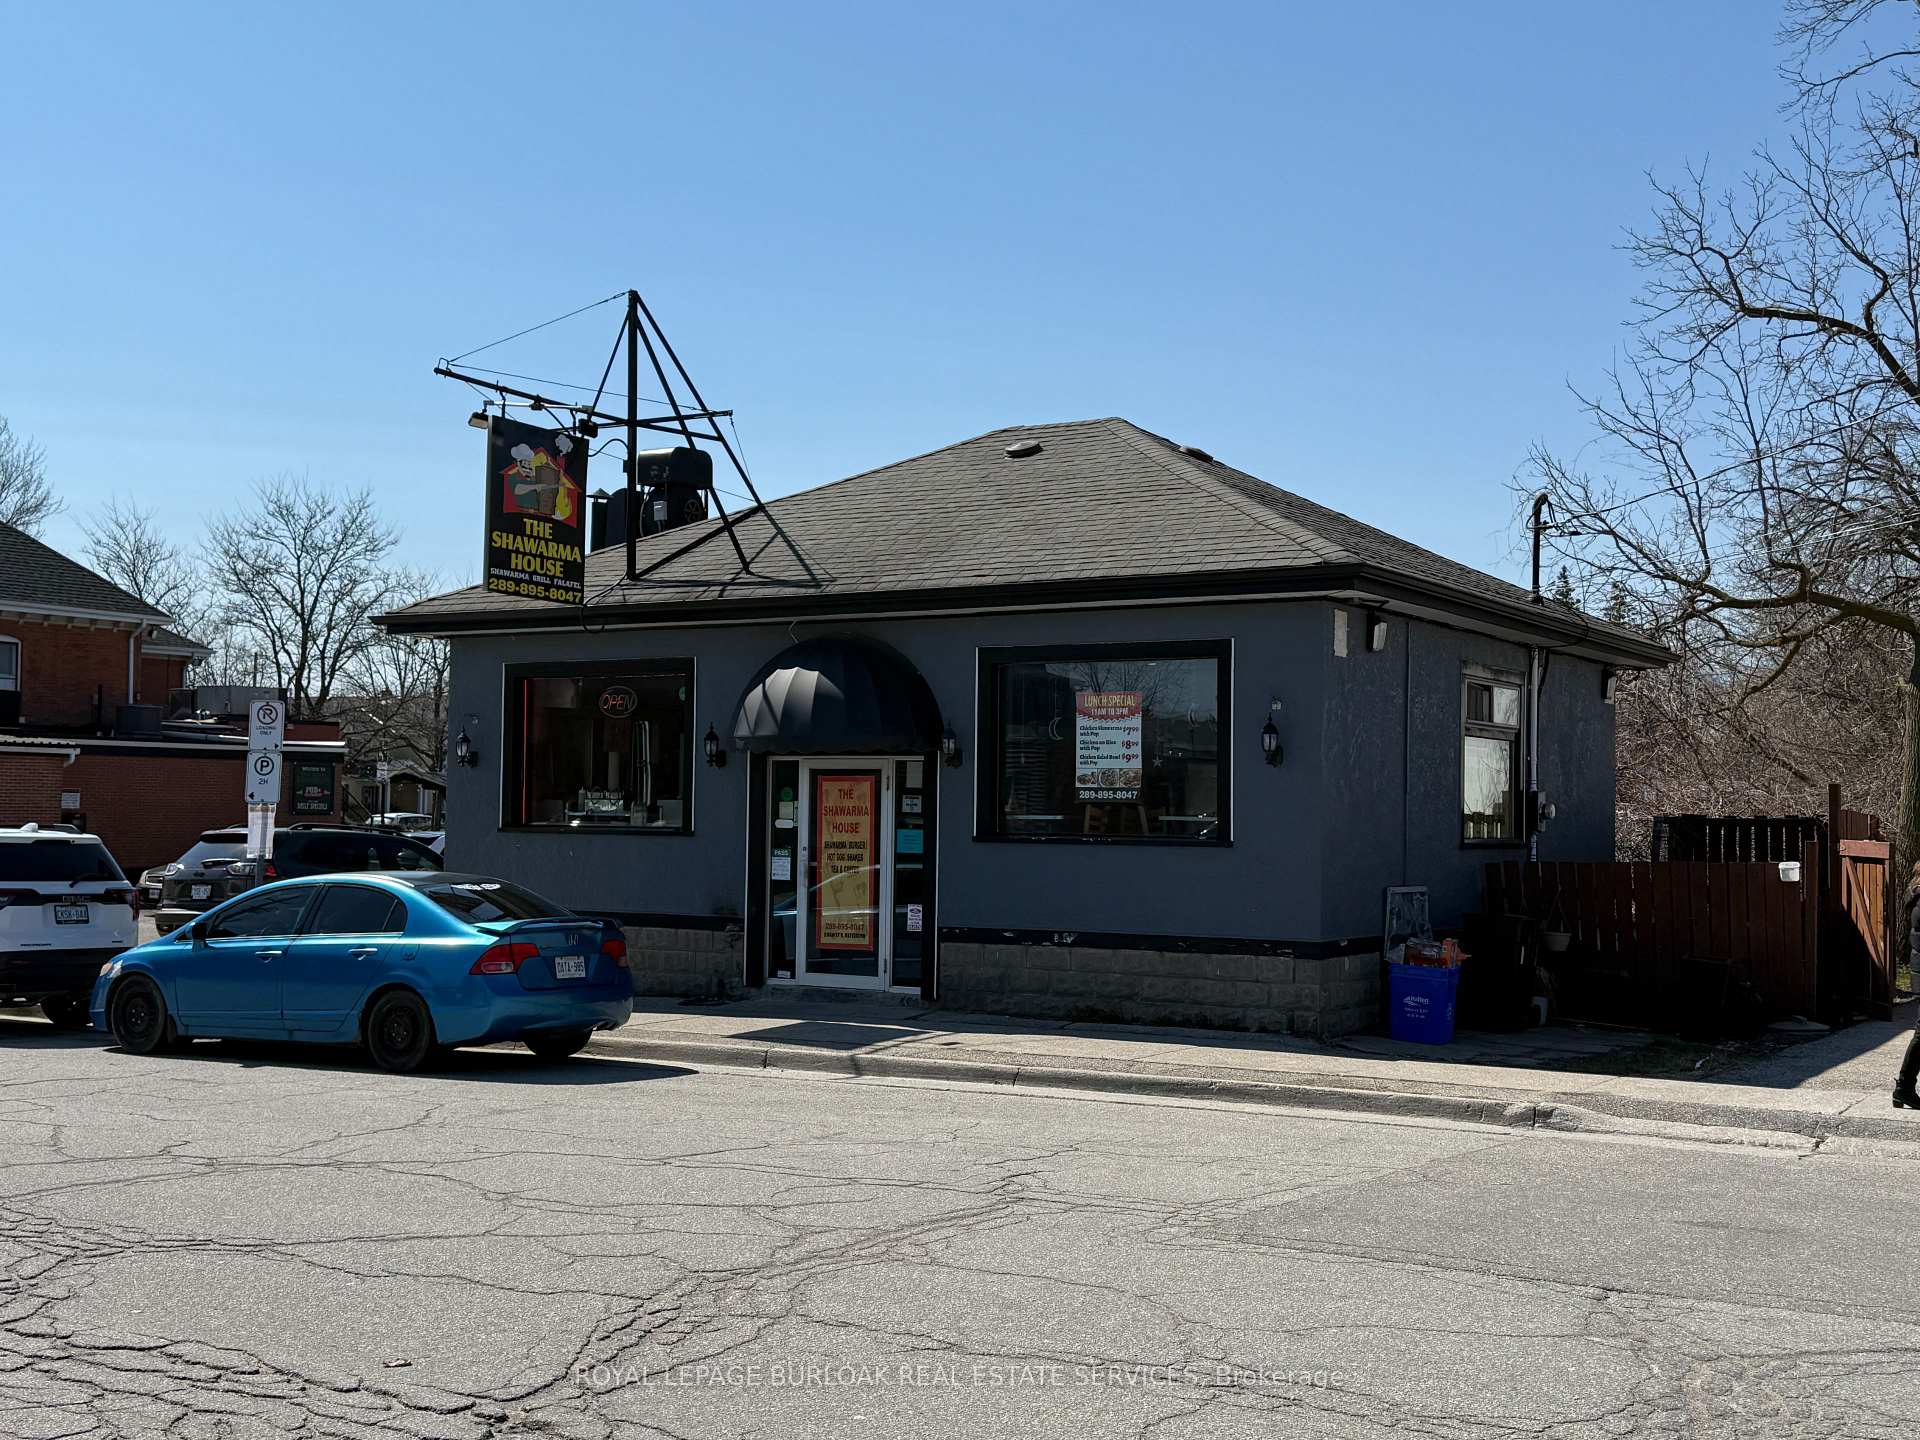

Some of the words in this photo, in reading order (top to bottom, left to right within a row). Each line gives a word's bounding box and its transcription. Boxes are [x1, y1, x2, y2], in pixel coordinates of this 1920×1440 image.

[523, 518, 553, 539] THE
[491, 531, 582, 563] SHAWARMA
[510, 553, 564, 578] HOUSE
[490, 567, 529, 581] SHAWARMA
[532, 574, 551, 584] GRILL
[553, 578, 581, 589] FALAFEL
[488, 577, 582, 603] 289-895-8047
[600, 694, 633, 711] OPEN
[1084, 695, 1108, 706] LUNCH
[1109, 695, 1135, 706] SPECIAL
[838, 788, 854, 801] THE
[1079, 790, 1138, 799] 289-895-8047
[824, 805, 869, 817] SHAWARMA
[832, 821, 860, 834] HOUSE
[773, 849, 789, 857] PASS
[827, 853, 836, 862] HOT
